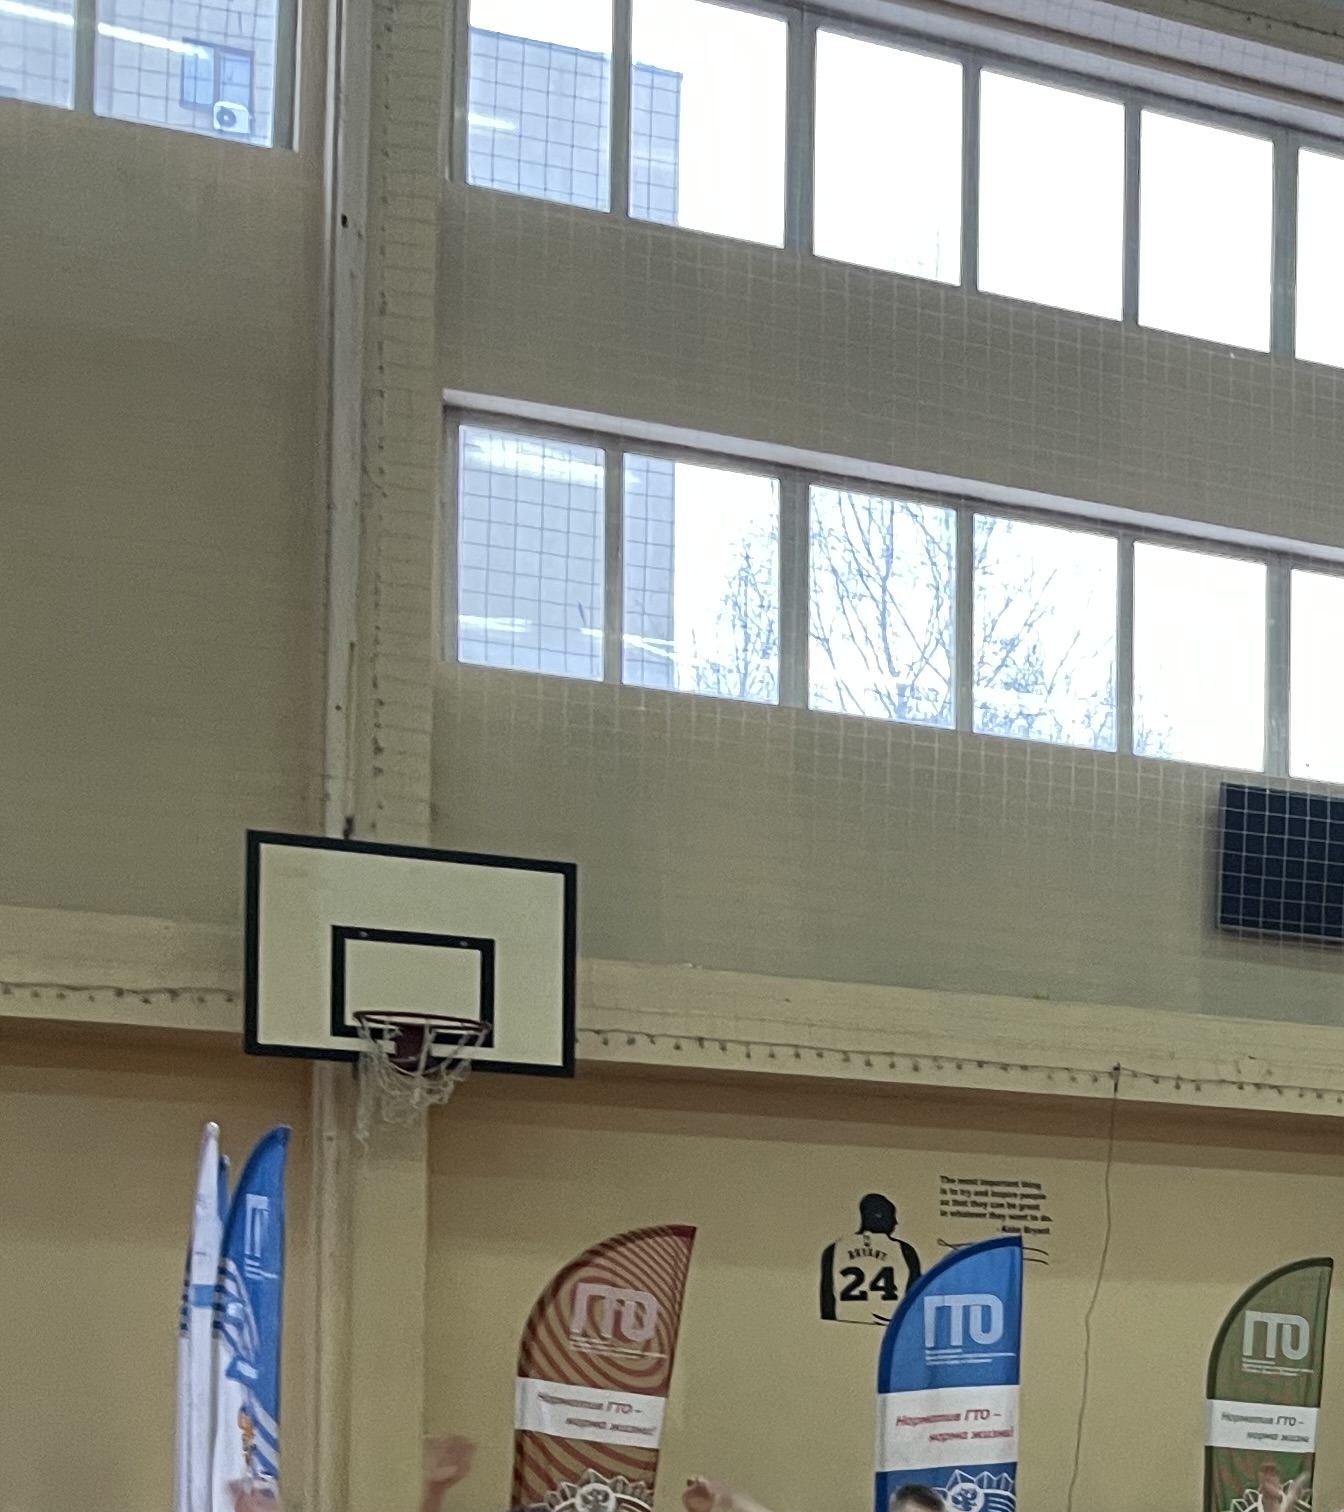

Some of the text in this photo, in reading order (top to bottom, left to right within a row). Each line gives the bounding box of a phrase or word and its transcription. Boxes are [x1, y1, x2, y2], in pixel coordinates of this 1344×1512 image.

[243, 1194, 271, 1258] ГТ
[840, 1266, 898, 1301] 24
[570, 1282, 658, 1342] ГТО
[924, 1293, 1004, 1345] ГТО
[1242, 1310, 1310, 1360] ГТО
[606, 1401, 633, 1414] ГТО
[964, 1409, 990, 1421] ГТО
[1276, 1416, 1297, 1427] ГТО
